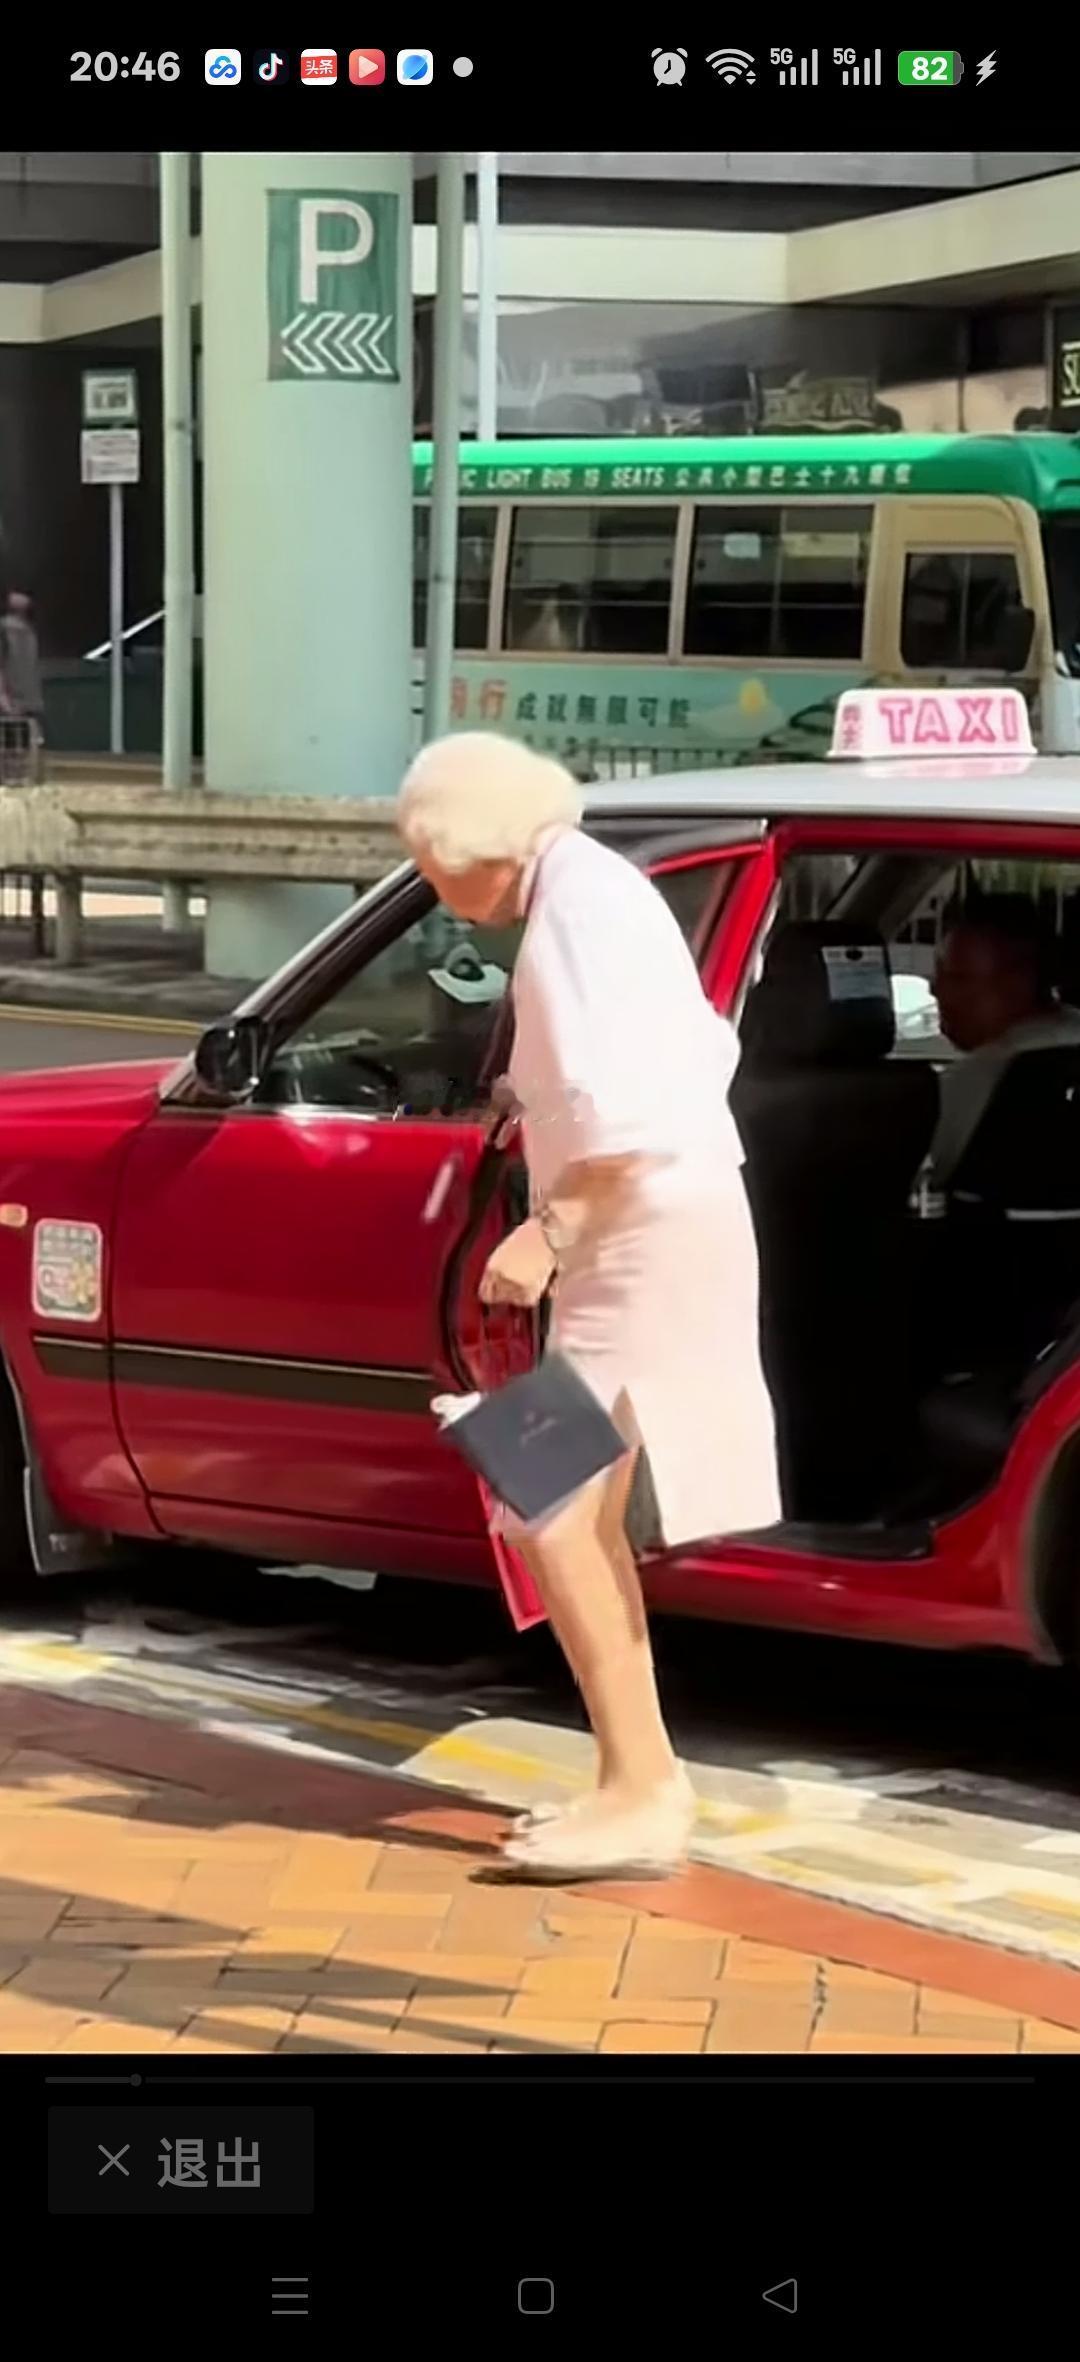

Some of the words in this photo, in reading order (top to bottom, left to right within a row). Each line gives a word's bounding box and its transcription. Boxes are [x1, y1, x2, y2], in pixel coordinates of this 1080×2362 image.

[300, 198, 374, 304] P
[541, 467, 572, 488] BUS
[611, 466, 664, 488] SEATS
[878, 697, 1019, 744] TAXI
